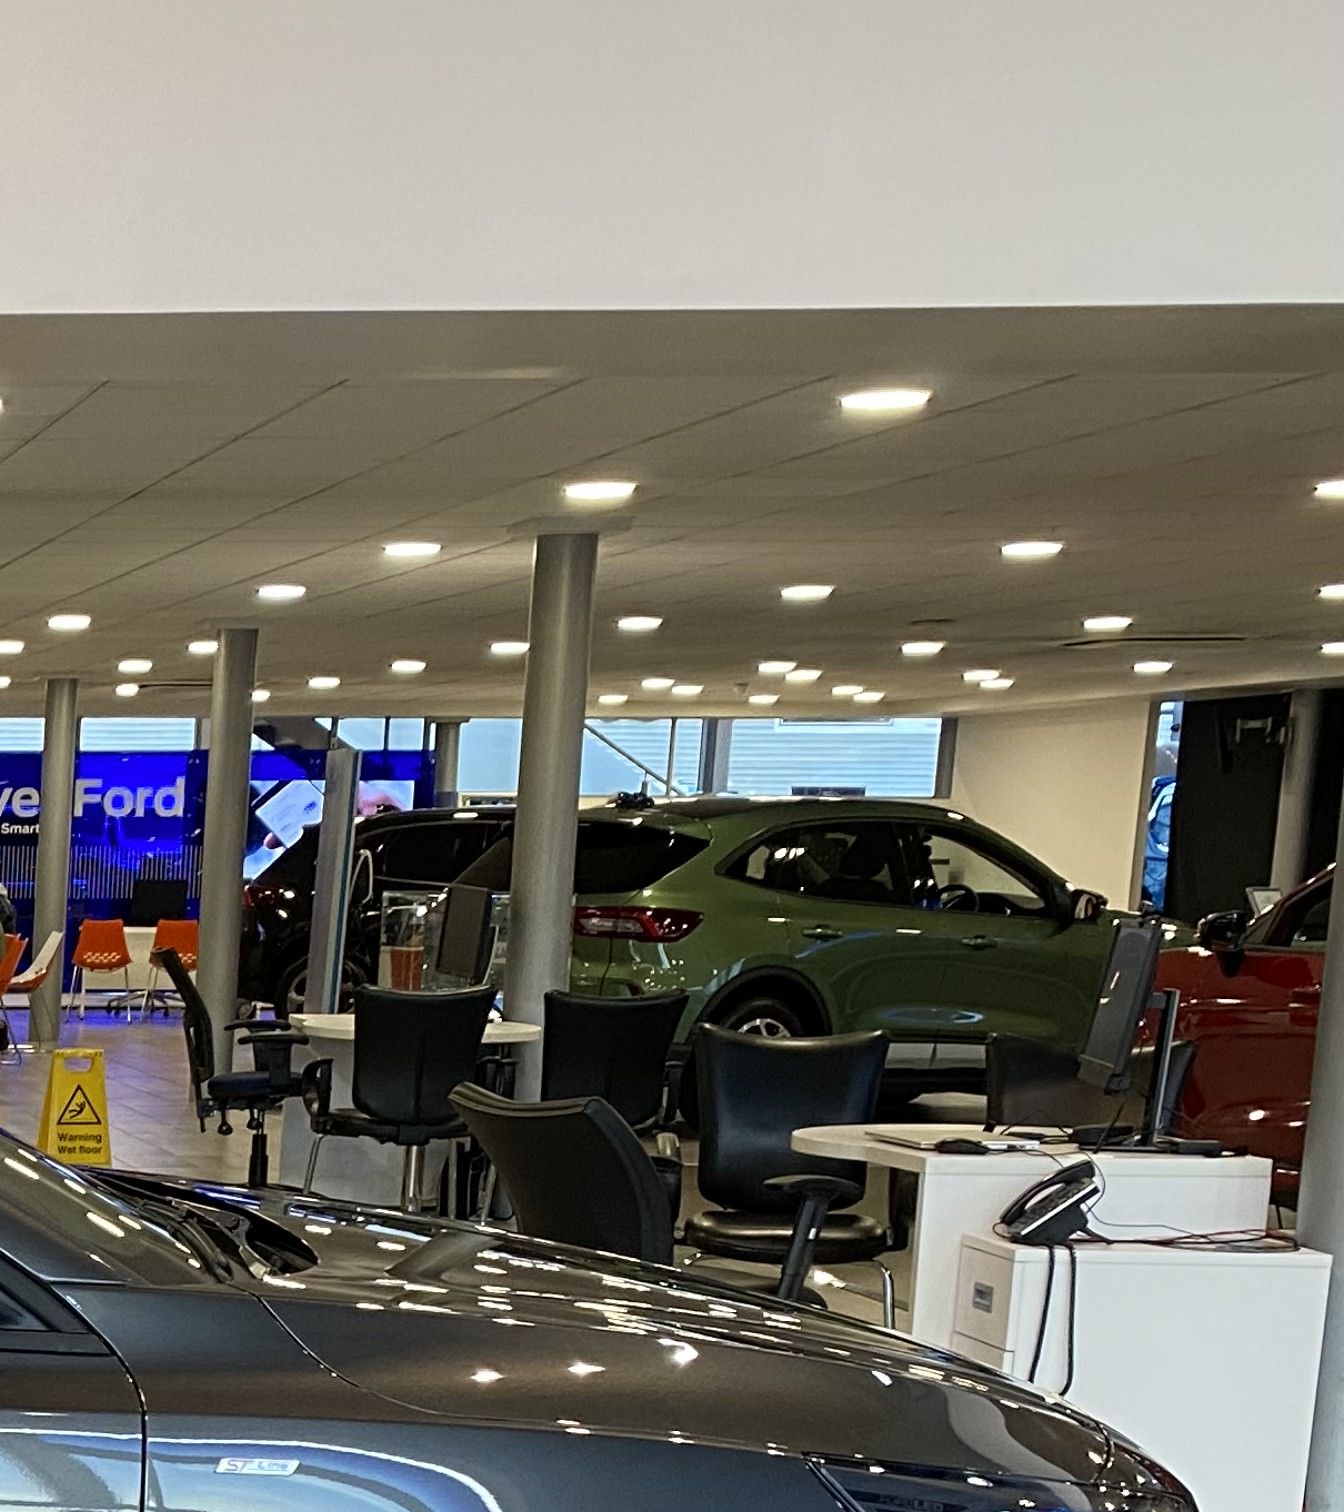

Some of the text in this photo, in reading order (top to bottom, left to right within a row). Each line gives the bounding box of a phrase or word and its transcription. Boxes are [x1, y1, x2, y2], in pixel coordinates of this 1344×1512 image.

[73, 777, 185, 818] Ford
[1, 822, 40, 835] Smart
[57, 1132, 102, 1145] Warning
[57, 1145, 102, 1154] Wet floor
[224, 1459, 255, 1472] ST
